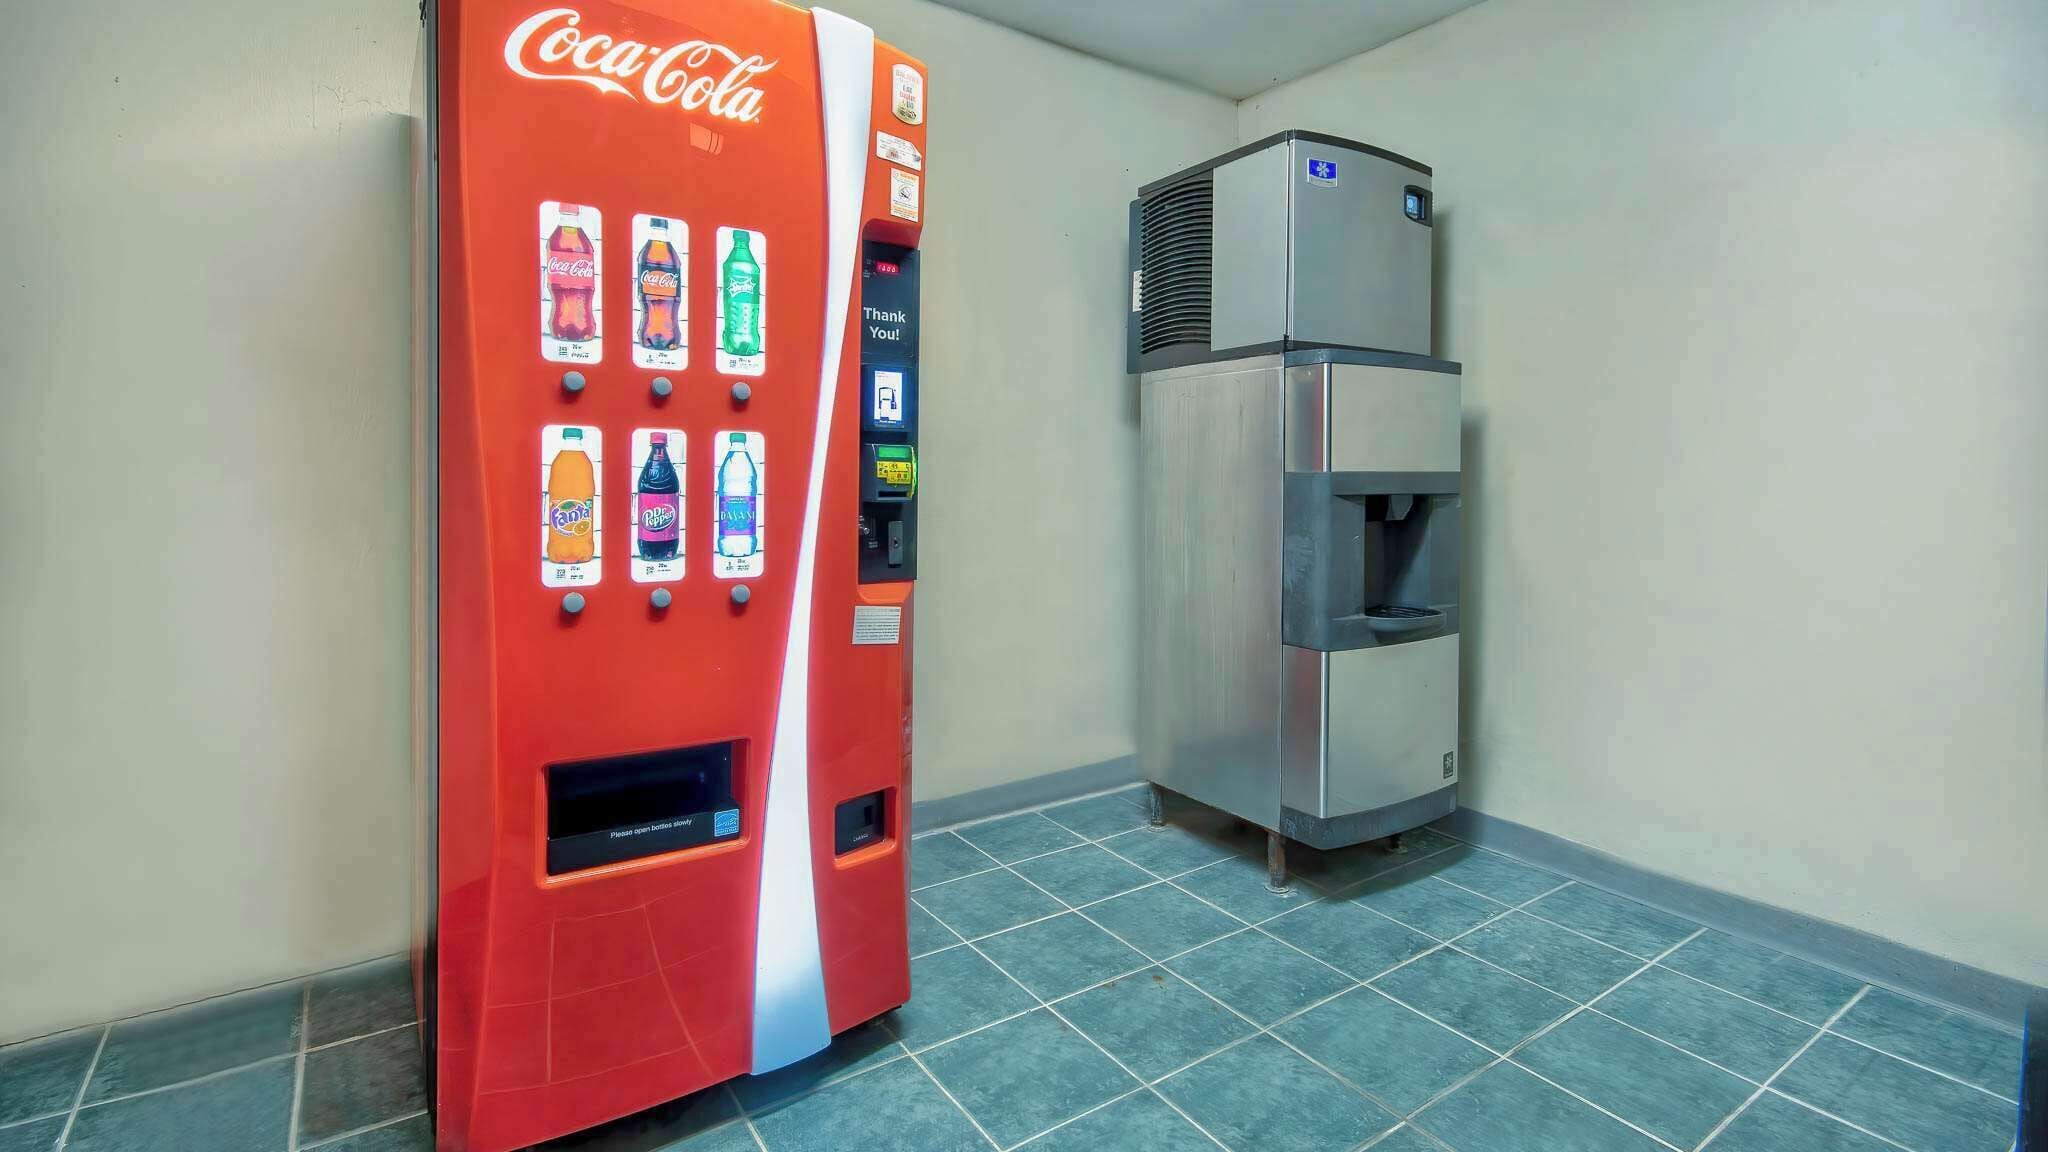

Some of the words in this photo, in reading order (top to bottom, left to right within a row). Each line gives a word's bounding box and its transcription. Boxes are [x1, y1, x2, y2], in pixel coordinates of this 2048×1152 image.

[504, 8, 778, 122] Coca-Cola
[547, 256, 593, 278] Coca-Cola
[641, 269, 679, 288] Coca-Cola
[863, 306, 906, 323] Thank
[869, 325, 900, 341] You!
[644, 508, 673, 527] Pepper
[652, 822, 672, 831] bottles
[673, 819, 692, 828] slowly
